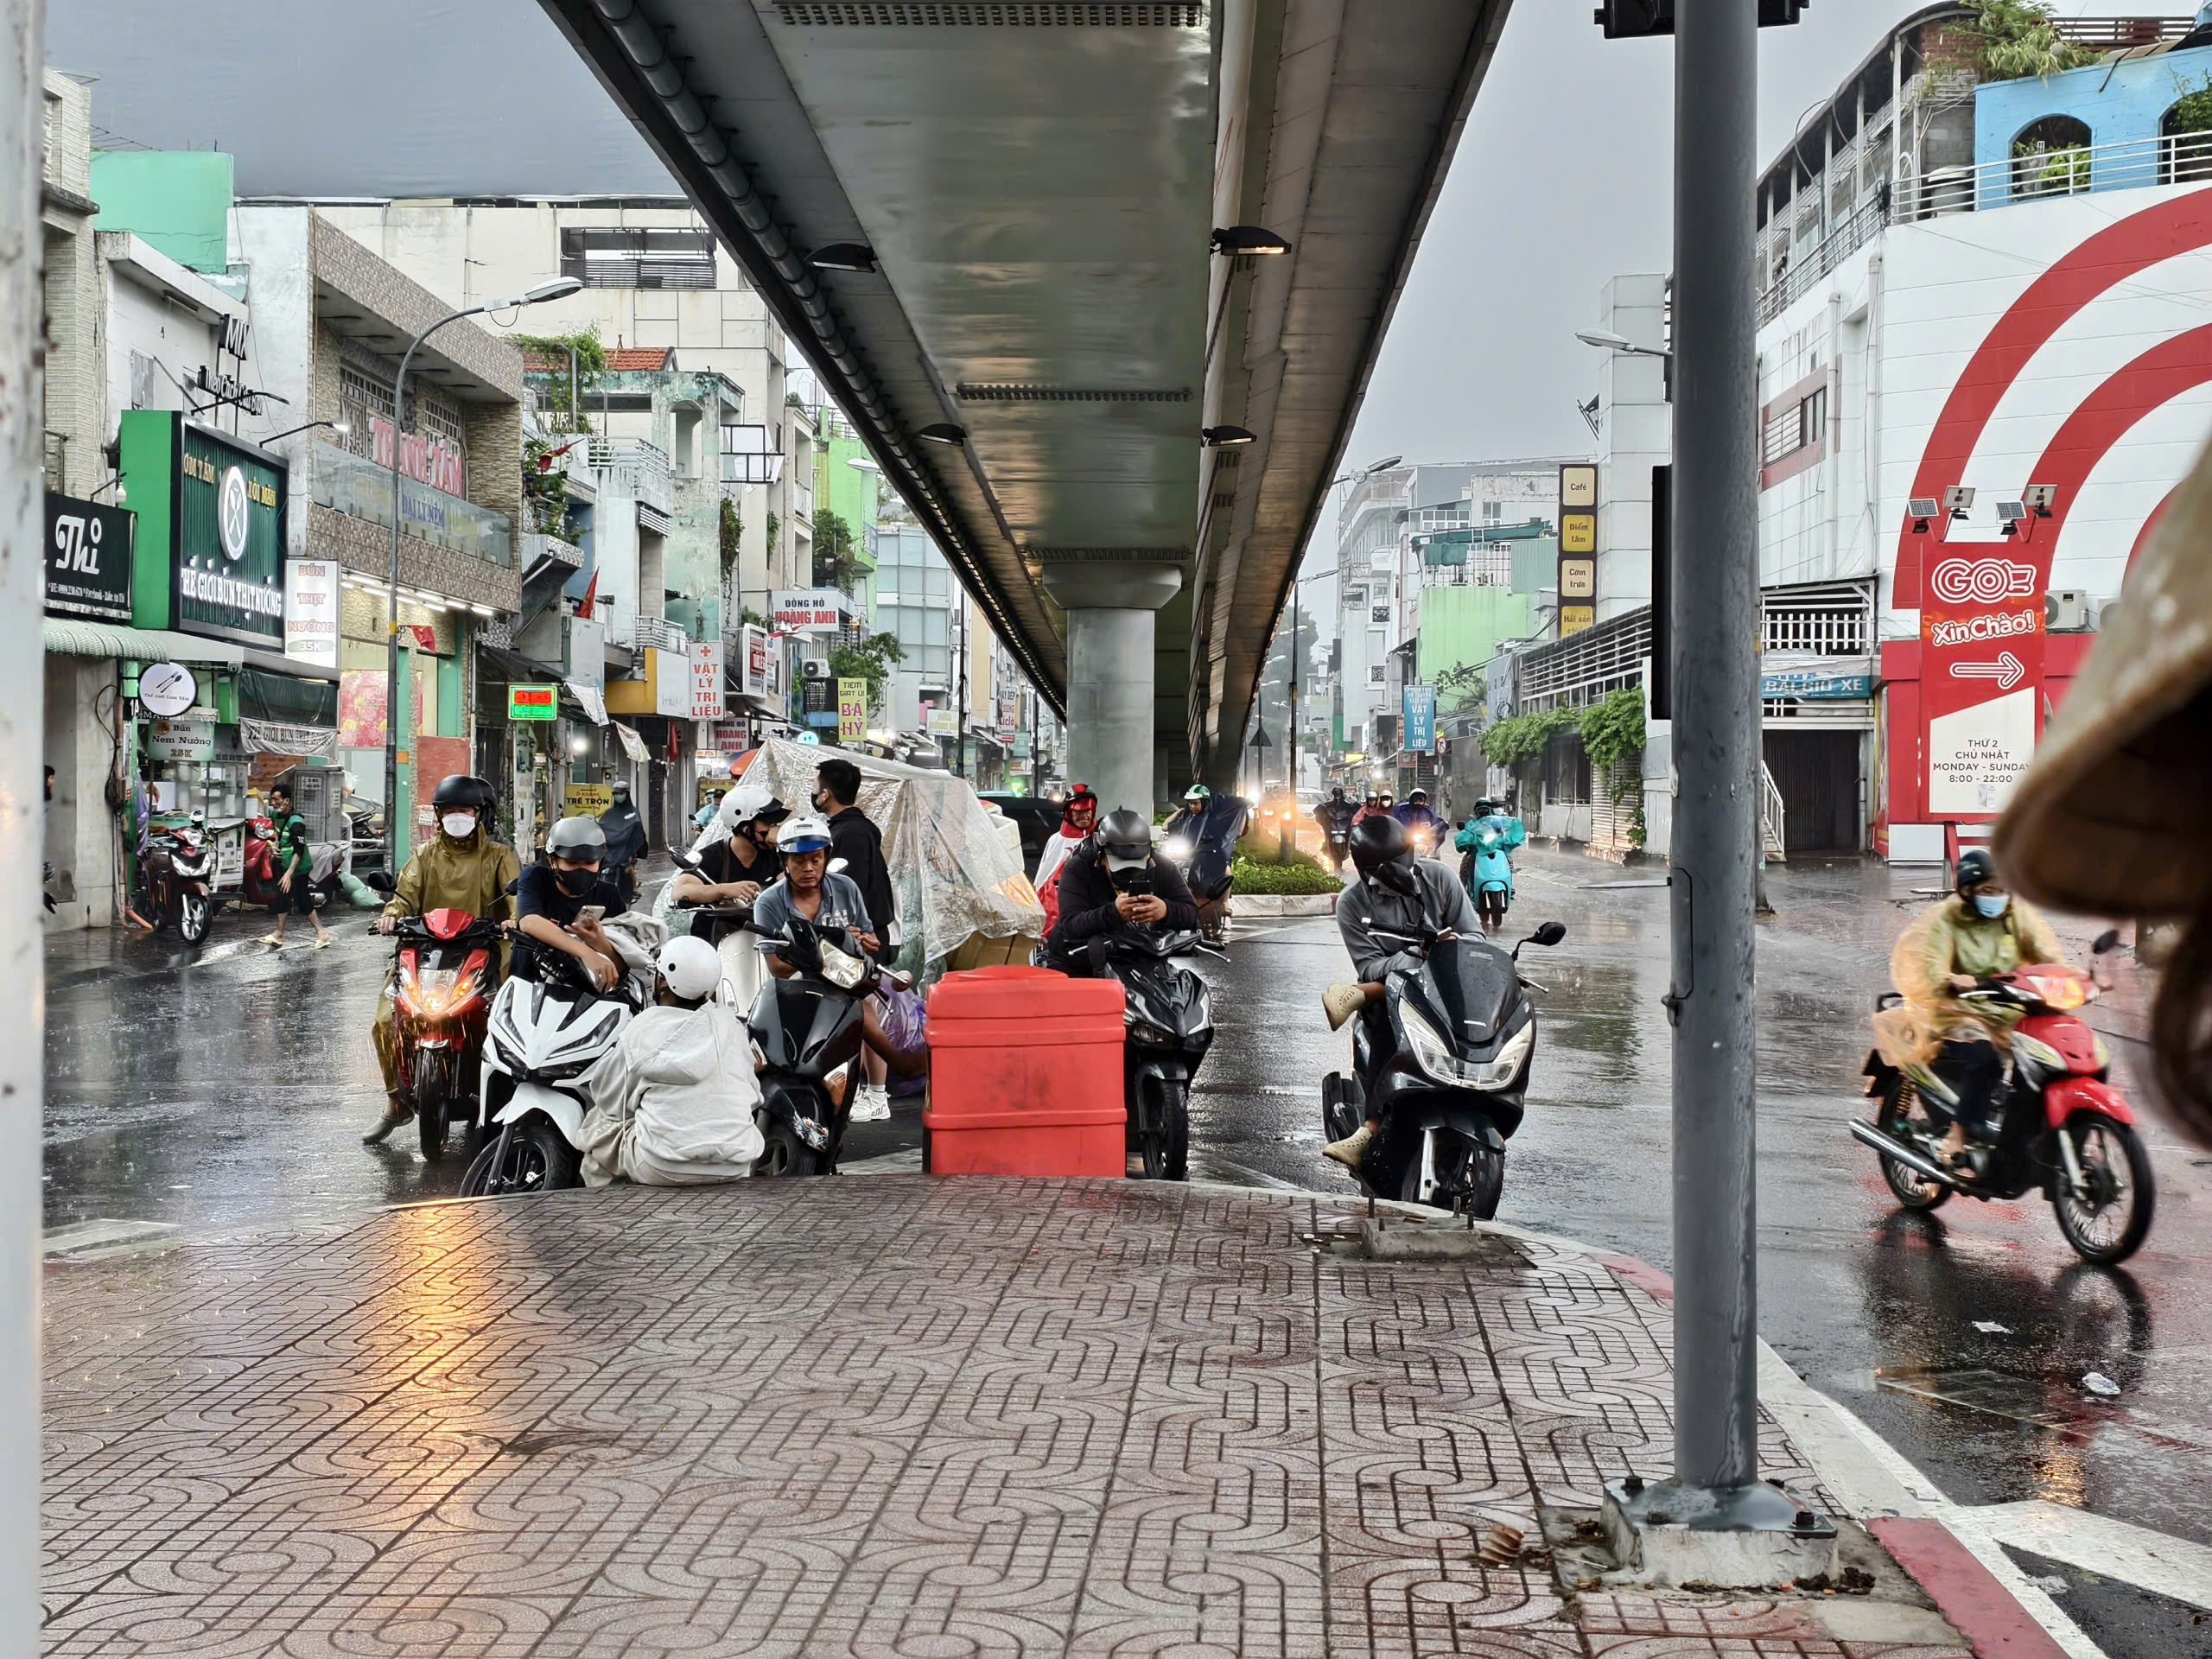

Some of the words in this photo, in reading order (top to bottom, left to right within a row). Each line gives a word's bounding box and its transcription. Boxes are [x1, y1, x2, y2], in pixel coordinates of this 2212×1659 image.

[55, 515, 102, 575] Thi
[297, 563, 326, 577] BÚN
[297, 593, 326, 607] THỊT
[814, 610, 836, 624] ANH
[287, 619, 335, 632] NƯỚNG
[694, 662, 719, 677] VẬT
[698, 676, 714, 688] LÝ
[1840, 678, 1864, 691] XE
[691, 704, 721, 719] LIỆU
[173, 724, 191, 733] Bún
[1967, 738, 1990, 747] THỨ
[1980, 750, 2011, 760] NHẬT
[1933, 762, 1980, 771] MONDAY
[1948, 774, 1973, 783] 8:00
[1983, 774, 2012, 783] 22:00
